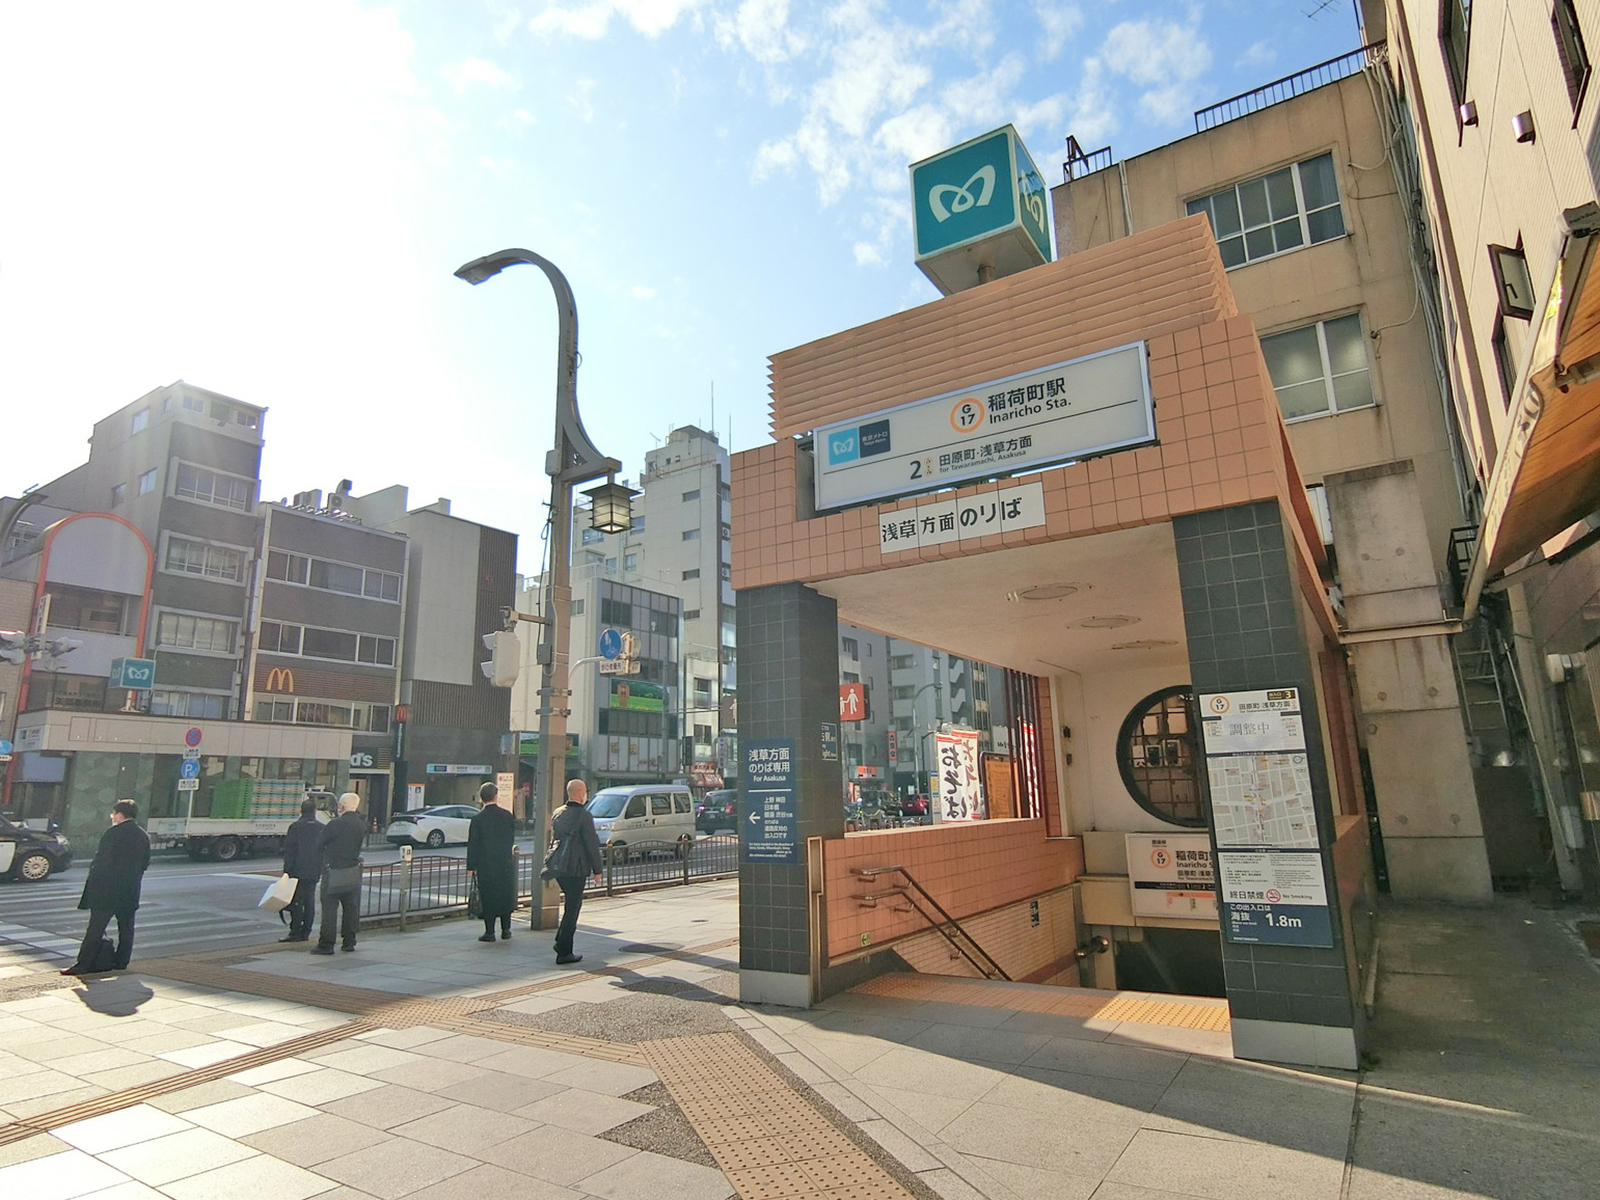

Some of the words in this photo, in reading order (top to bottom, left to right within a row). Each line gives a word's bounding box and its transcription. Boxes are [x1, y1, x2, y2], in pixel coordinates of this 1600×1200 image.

[988, 377, 1066, 412] 稲荷町駅
[961, 404, 972, 414] G
[989, 403, 1042, 425] Inaricho
[1045, 396, 1072, 411] Sta.
[960, 413, 976, 426] 17
[939, 466, 949, 474] for
[997, 449, 1026, 461] Asakusa
[910, 460, 923, 480] 2
[882, 497, 1023, 543] 浅草方面のりば
[1284, 690, 1292, 699] 3
[1229, 722, 1270, 736] 調整中
[748, 747, 790, 762] 浅草方面
[748, 761, 790, 773] のりば専用
[1175, 850, 1211, 862] 稲荷町
[1176, 861, 1208, 869] Inaricho
[1230, 890, 1265, 900] 終日禁煙
[1230, 903, 1272, 912] この出入口は
[1230, 911, 1251, 921] 海抜
[1265, 912, 1302, 928] 1.8m
